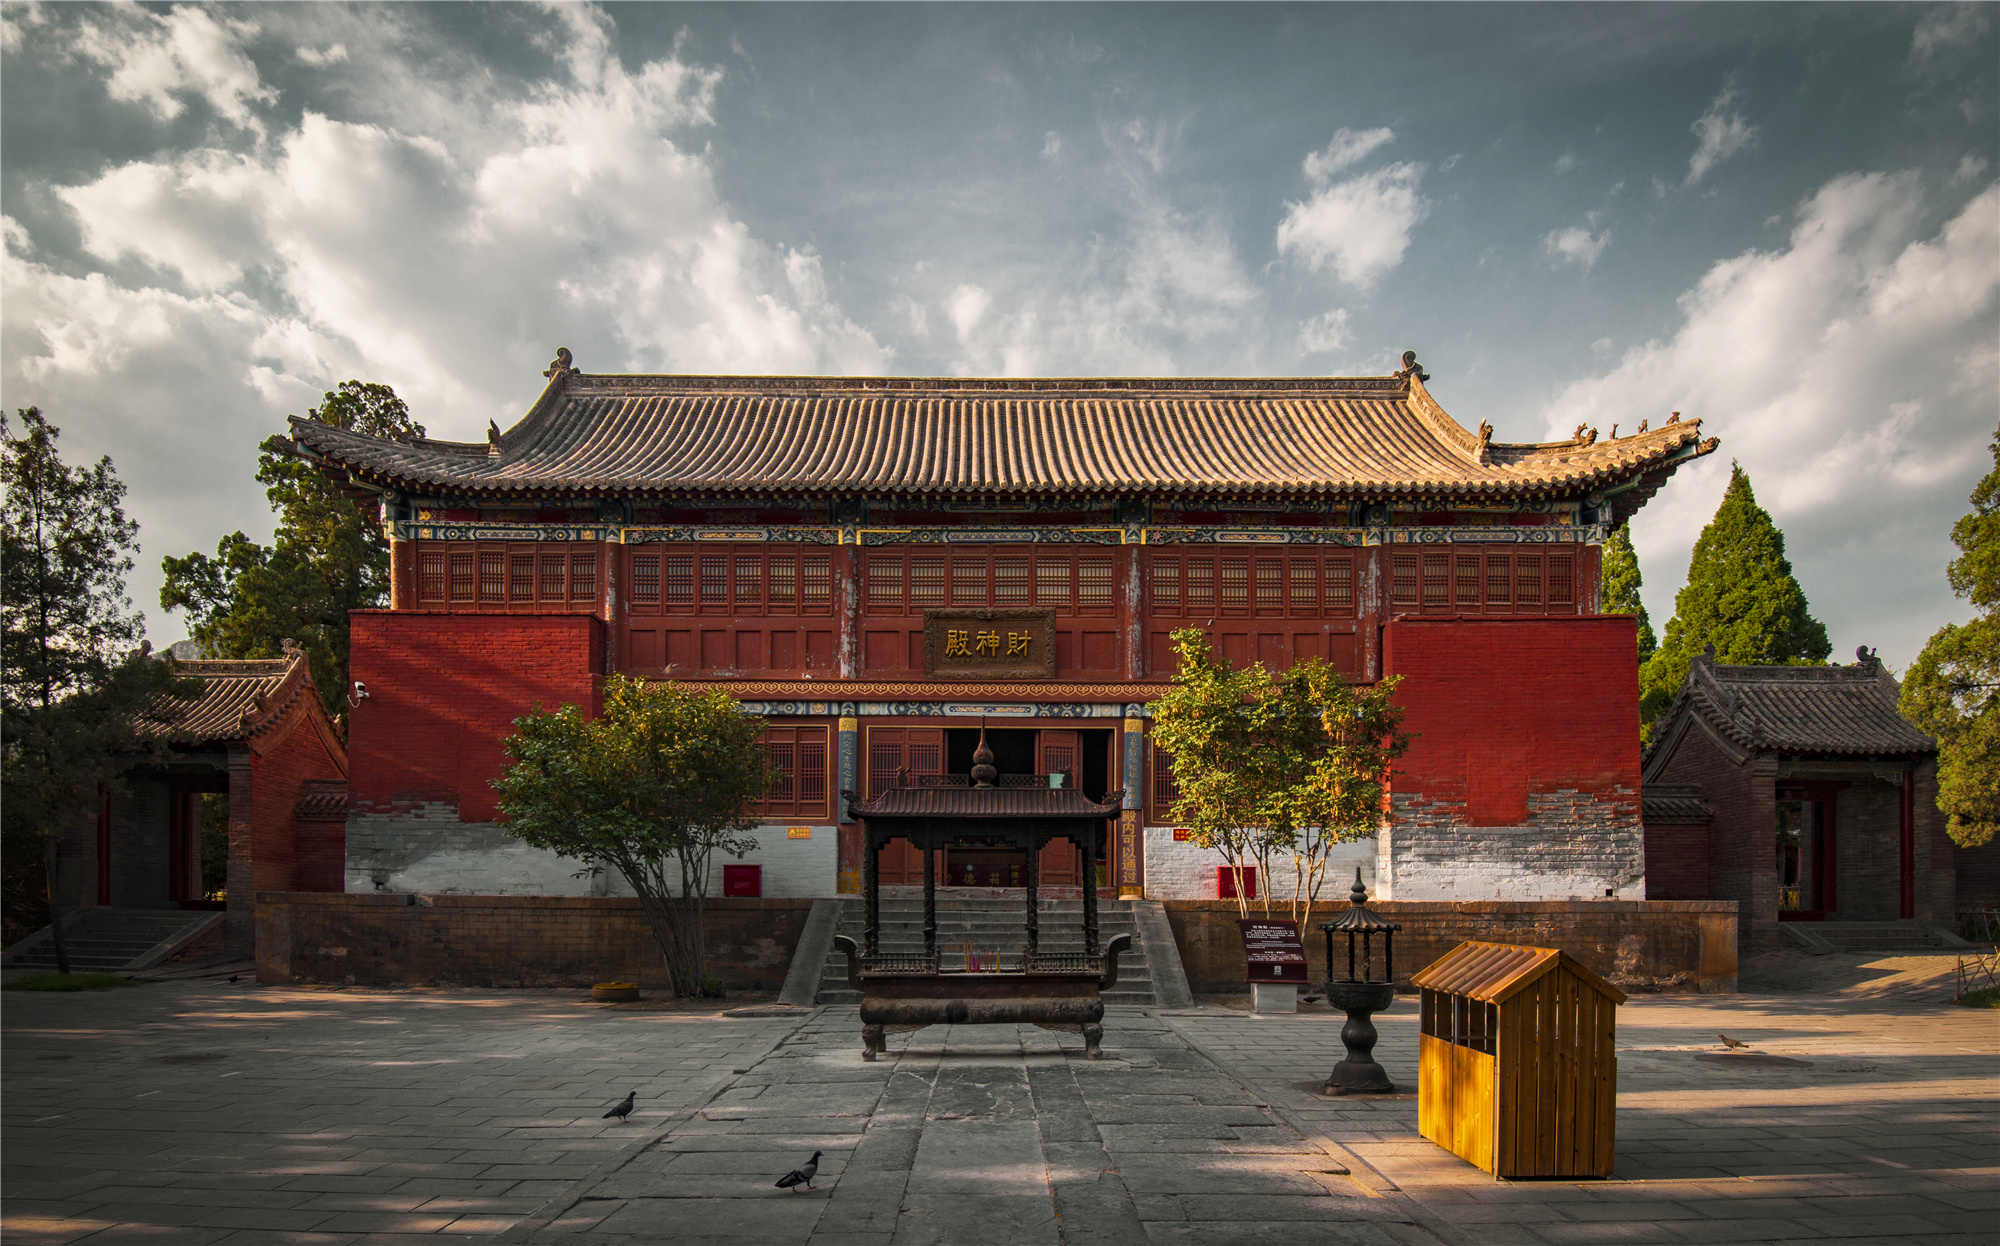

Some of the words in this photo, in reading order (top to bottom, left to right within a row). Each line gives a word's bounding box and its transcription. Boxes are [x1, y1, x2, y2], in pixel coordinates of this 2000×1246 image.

[1121, 810, 1137, 883] 殿内可以通过
